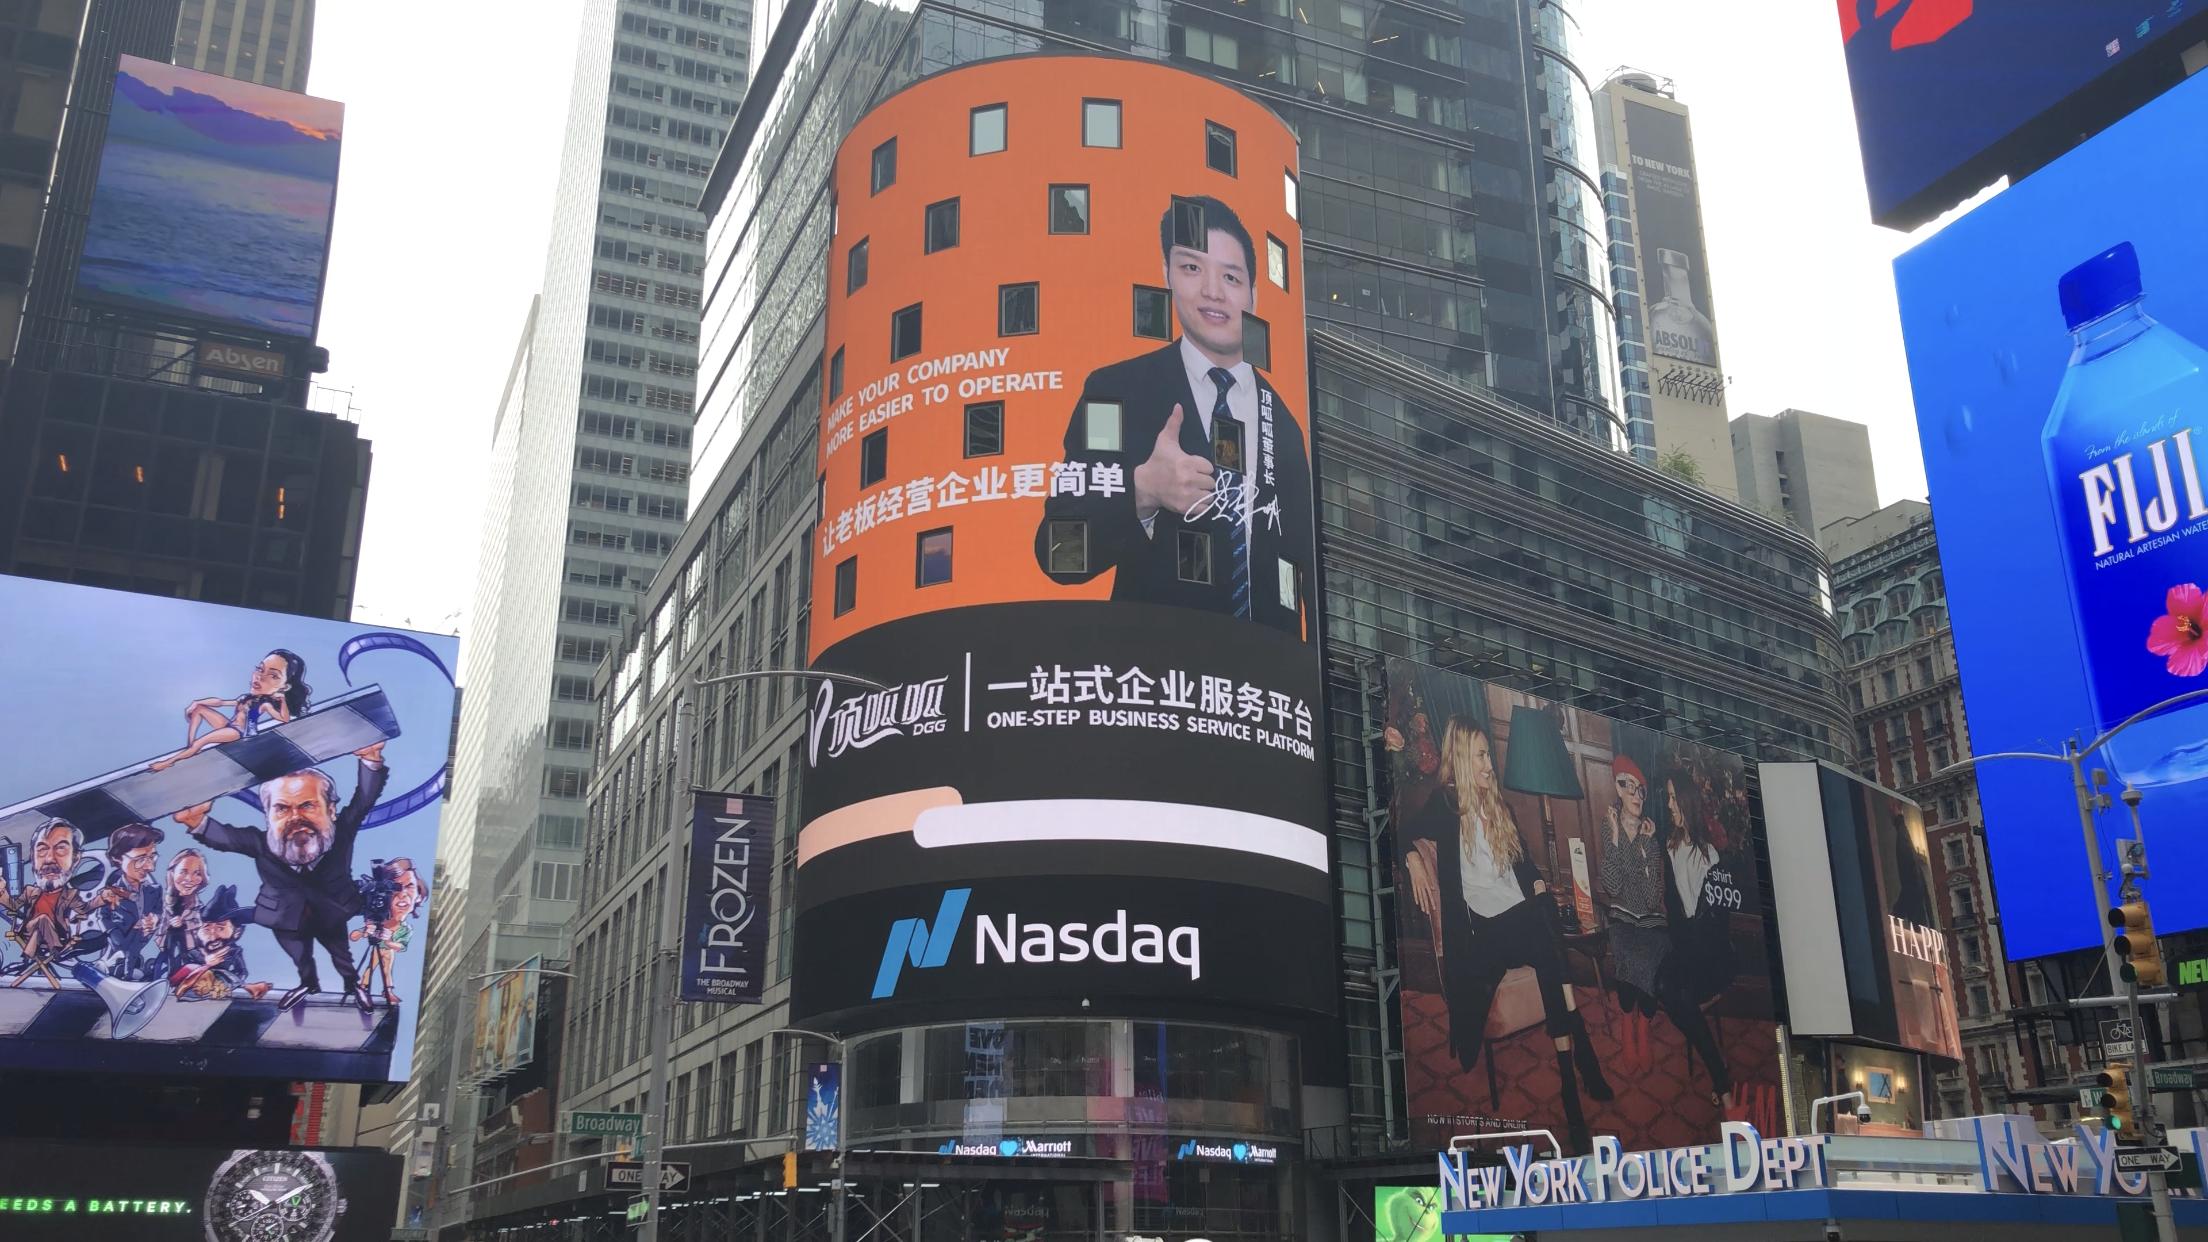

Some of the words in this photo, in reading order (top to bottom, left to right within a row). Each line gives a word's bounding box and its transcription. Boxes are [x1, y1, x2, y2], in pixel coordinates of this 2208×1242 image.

[1631, 154, 1643, 166] TO
[1645, 158, 1664, 171] NEW
[206, 347, 279, 372] Absen
[827, 396, 853, 433] MAKE
[858, 371, 900, 407] YOUR
[907, 347, 1010, 385] COMPANY
[826, 421, 854, 459] MORE
[859, 394, 914, 432] EASIER
[922, 383, 949, 405] TO
[958, 371, 1063, 399] OPERATE
[2084, 444, 2111, 460] From
[2114, 429, 2129, 448] the
[2079, 428, 2208, 557] FIJI
[822, 460, 1126, 557] 让老板经营企业更简单
[2095, 549, 2134, 570] NATURAL
[2136, 531, 2180, 555] ARTESIAN
[2181, 519, 2208, 537] WATE
[987, 664, 1313, 741] 一站式企业服务平台
[913, 719, 947, 736] DGG
[987, 709, 1080, 729] ONE-STEP
[1089, 710, 1180, 730] BUSINESS
[1187, 716, 1251, 741] SERVICE
[1256, 727, 1315, 762] PLATFORM
[1705, 867, 1733, 885] -shirt
[700, 817, 756, 973] FROZEN
[1704, 880, 1742, 910] $9.99
[975, 909, 1201, 981] Nasdaq
[696, 978, 710, 986] THE
[711, 979, 749, 988] BROADWAY
[706, 987, 736, 996] MUSICAL
[2107, 1043, 2124, 1053] BIKE
[2155, 1070, 2192, 1088] Broadway
[575, 1114, 641, 1137] Broadway
[955, 1143, 997, 1156] Nasdaq
[1022, 1139, 1072, 1153] Marriott
[1196, 1145, 1232, 1160] Nasdaq
[1249, 1145, 1277, 1158] Marriott
[1974, 1118, 2080, 1194] NEW
[1438, 1151, 1503, 1210] NEW
[1502, 1144, 1590, 1206] YORK
[1593, 1135, 1713, 1200] POLICE
[1721, 1121, 1831, 1192] DEPT
[2121, 1155, 2141, 1165] ONE
[2151, 1154, 2170, 1164] WAY
[618, 1170, 641, 1181] ONE
[64, 1200, 77, 1211] A
[89, 1199, 192, 1213] BATTERY.
